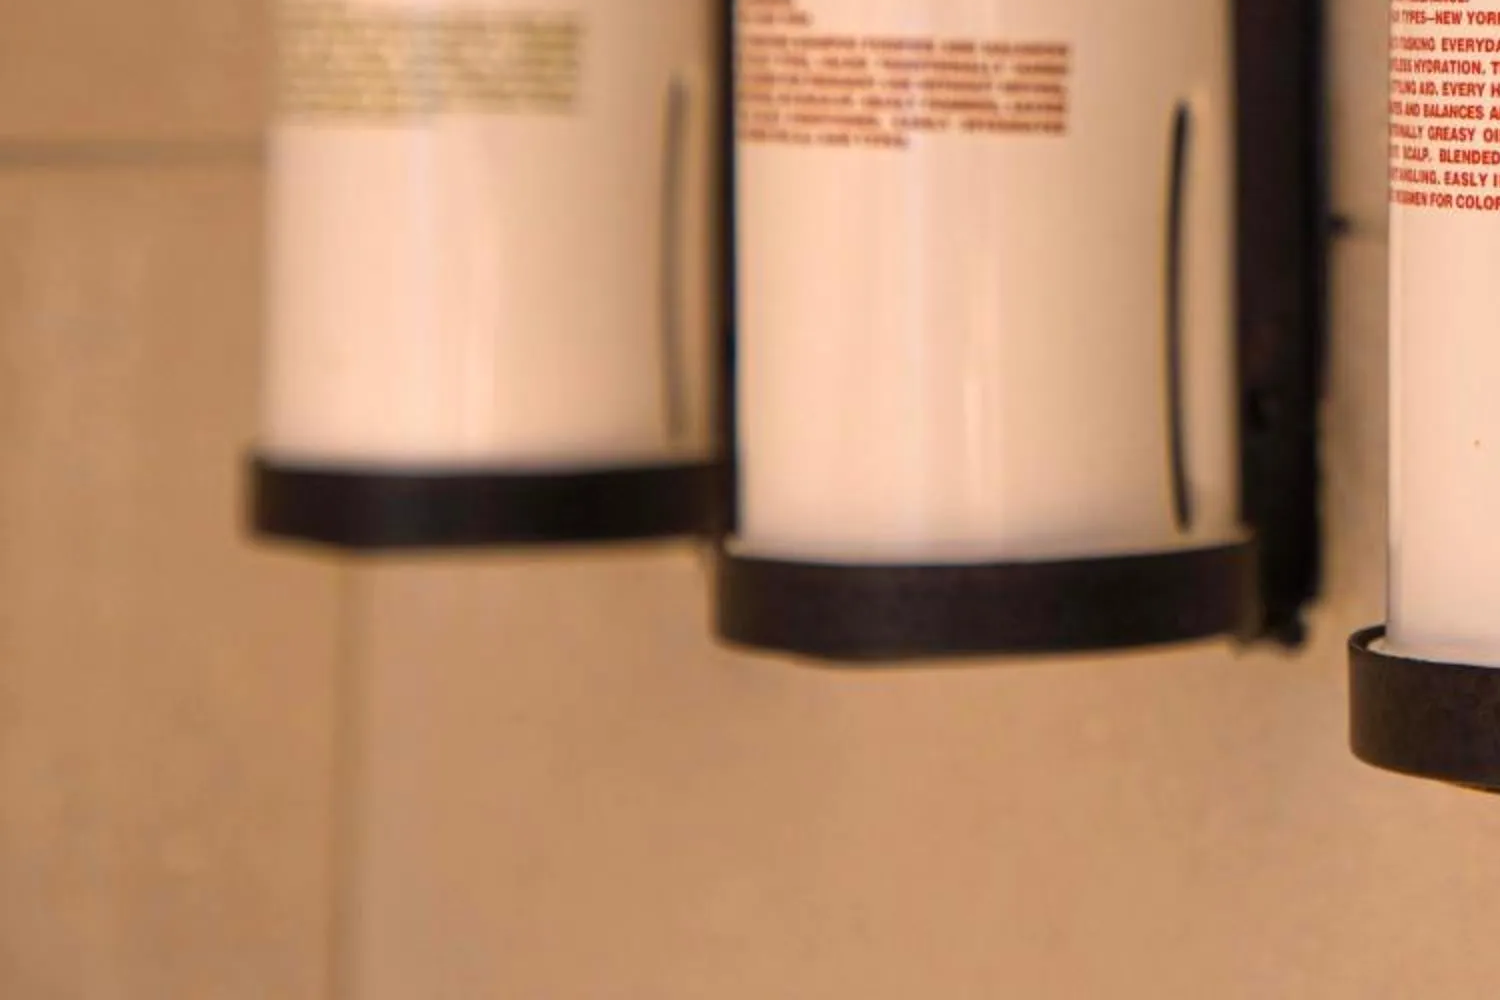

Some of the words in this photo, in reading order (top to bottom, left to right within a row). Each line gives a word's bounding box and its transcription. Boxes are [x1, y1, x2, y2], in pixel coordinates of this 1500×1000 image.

[1442, 82, 1485, 97] EVERY
[1423, 104, 1485, 119] BALANCES
[1427, 125, 1475, 141] GREASY
[1430, 192, 1453, 208] FOR
